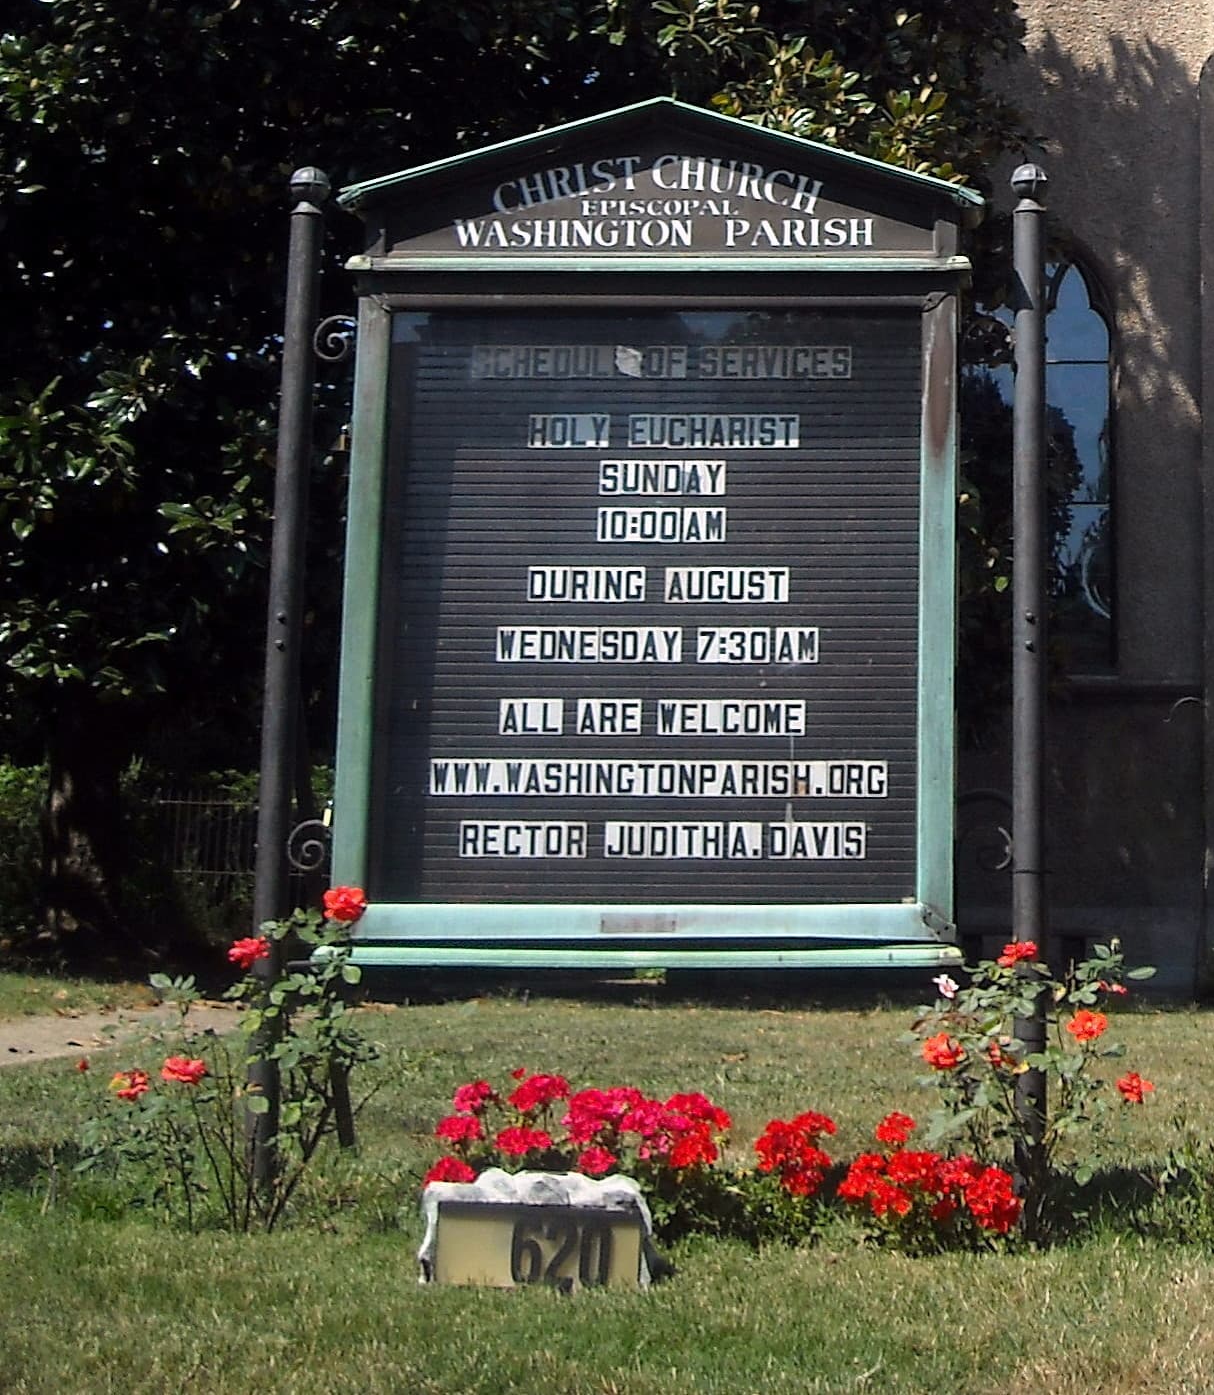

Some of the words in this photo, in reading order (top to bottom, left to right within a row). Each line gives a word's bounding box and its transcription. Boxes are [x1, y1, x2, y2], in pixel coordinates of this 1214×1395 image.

[492, 156, 641, 215] CHRIST
[652, 154, 823, 215] CHURCH
[581, 199, 739, 217] EPISCOPAL
[455, 218, 693, 248] WASHINGTON
[725, 218, 874, 247] PARISH
[645, 347, 687, 377] OF
[701, 347, 850, 378] SERVICES
[530, 416, 609, 447] HOLY
[630, 416, 798, 447] EUCHARIST
[600, 462, 725, 494] SUNDAY
[529, 568, 645, 601] DURING
[667, 569, 788, 601] AUGUST
[498, 629, 681, 661] WEDNESDAY
[502, 700, 561, 734] ALL
[578, 701, 641, 734] ARE
[658, 701, 804, 734] WELCOME
[432, 761, 886, 796] WWW.WASHINGTONPARISH.ORG
[461, 823, 586, 856] RECTOR
[606, 823, 721, 857] JUDITH
[770, 825, 864, 857] DAVIS
[511, 1214, 613, 1294] 620
